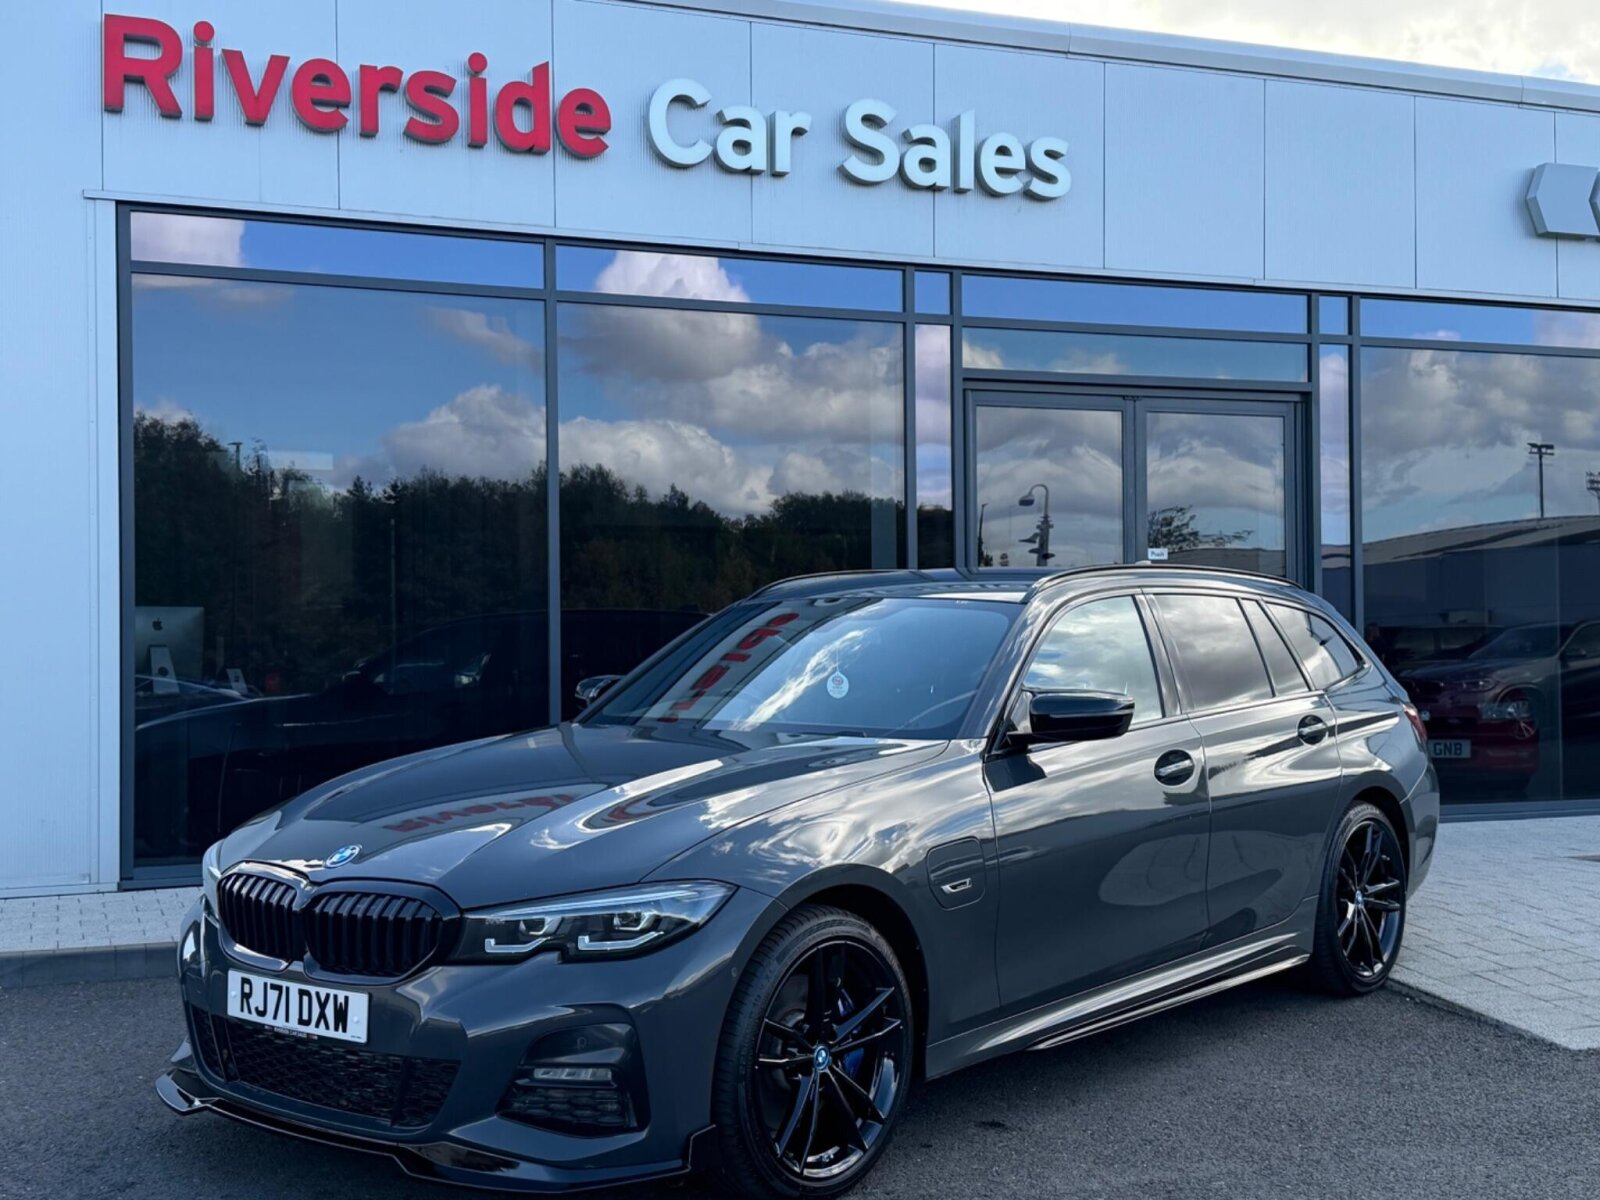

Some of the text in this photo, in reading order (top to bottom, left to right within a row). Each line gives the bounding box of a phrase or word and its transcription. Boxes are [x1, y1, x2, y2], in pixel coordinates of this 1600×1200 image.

[103, 13, 1071, 200] Riverside Car Sales
[1433, 742, 1463, 756] GNB
[240, 976, 350, 1033] RJ71 DXW
